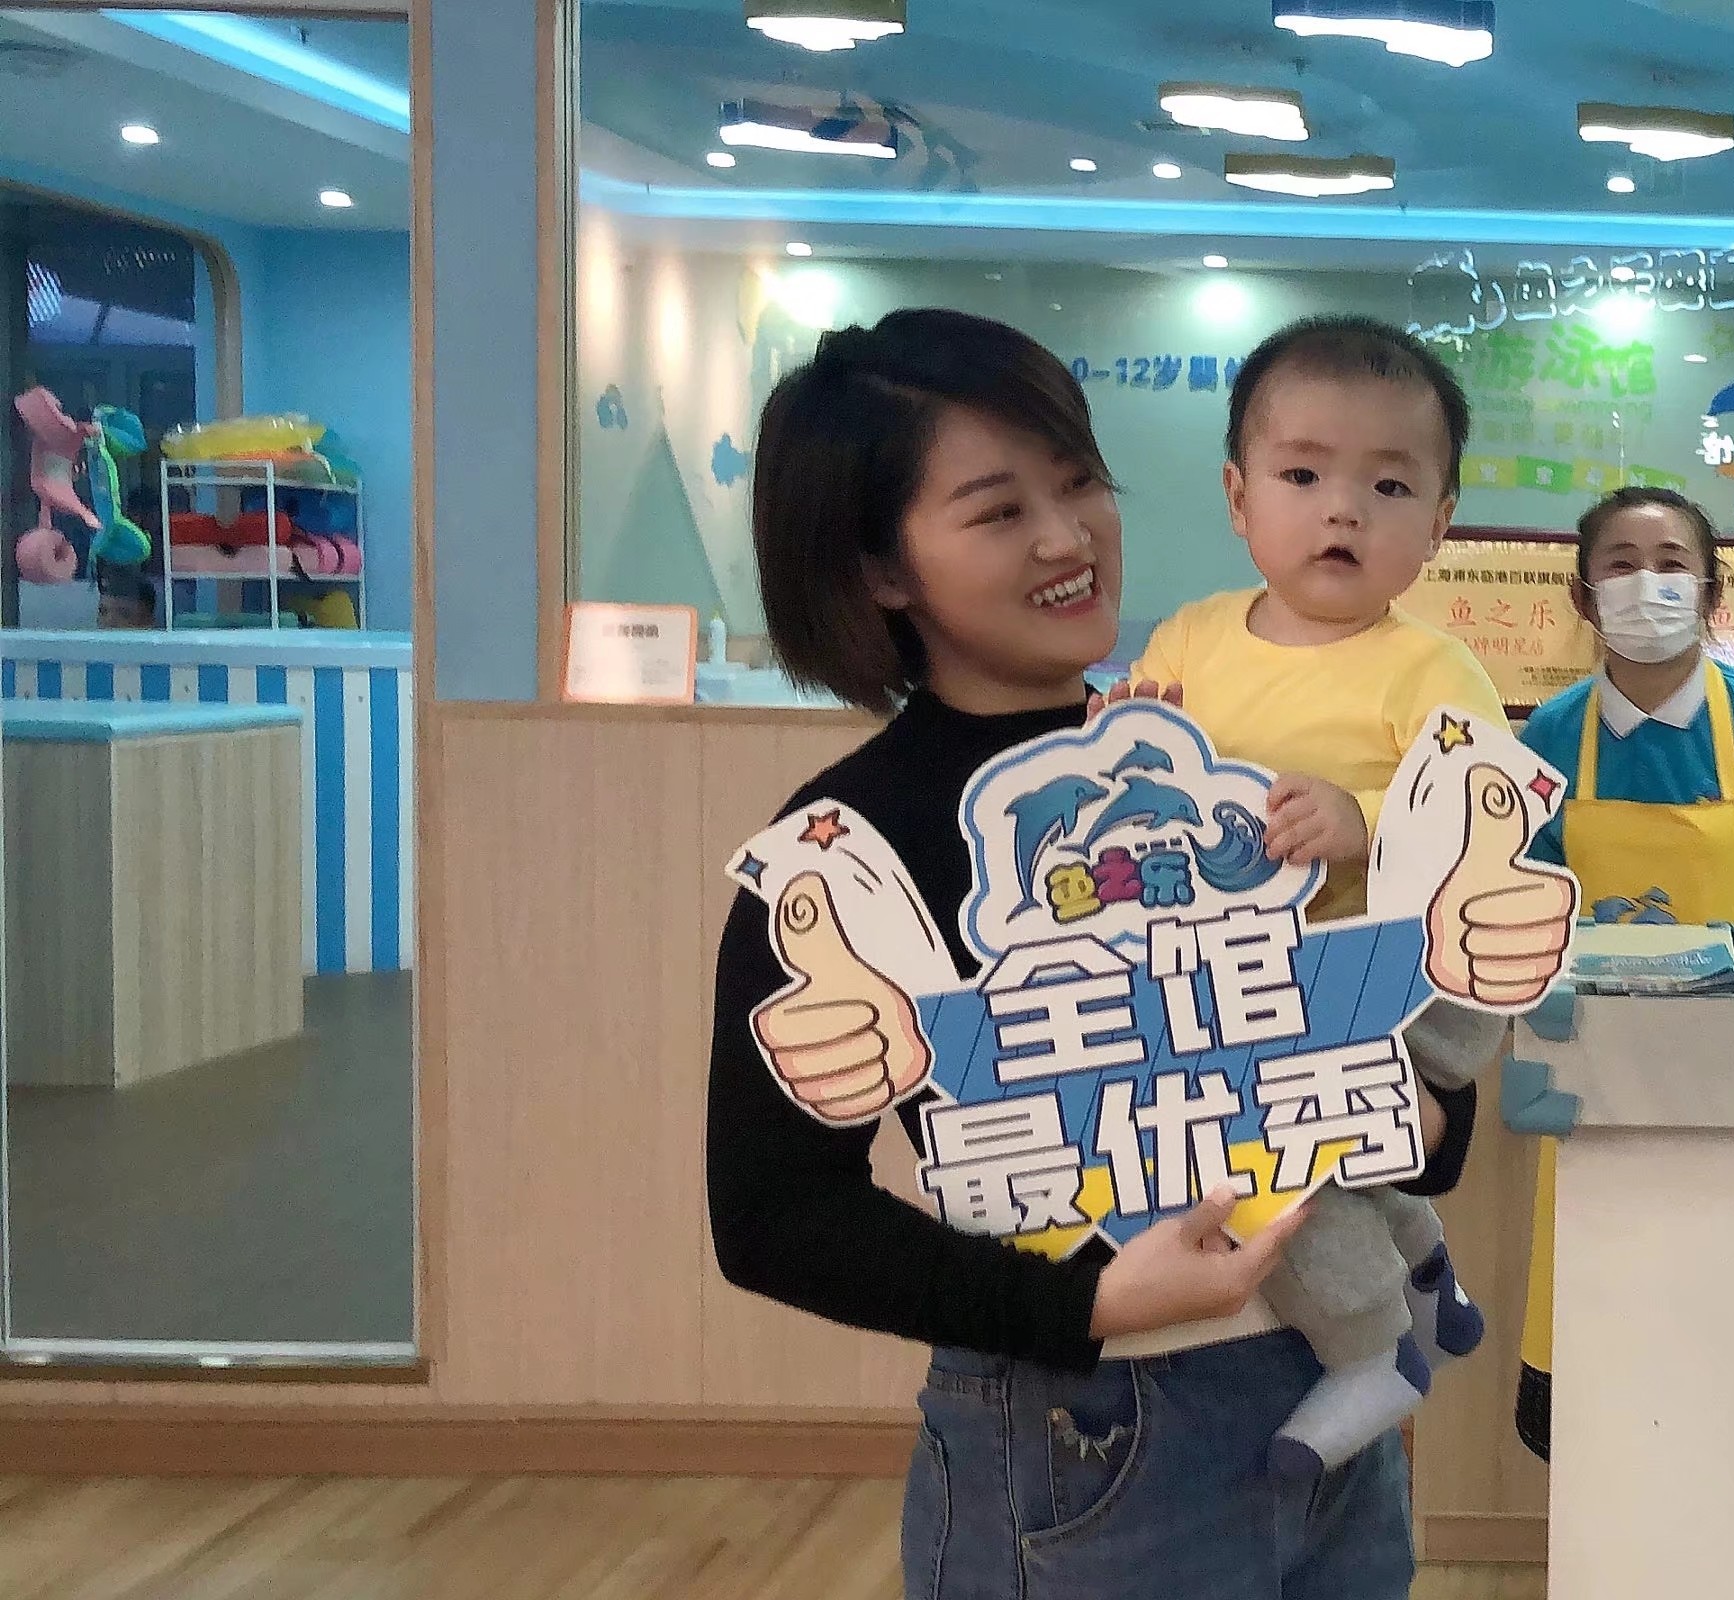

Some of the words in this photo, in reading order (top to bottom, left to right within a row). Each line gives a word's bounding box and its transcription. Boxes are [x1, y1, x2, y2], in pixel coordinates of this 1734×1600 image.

[1446, 595, 1557, 630] 鱼之乐
[1045, 846, 1196, 925] 鱼之乐
[981, 905, 1308, 1086] 全馆
[922, 1036, 1424, 1236] 最优秀
